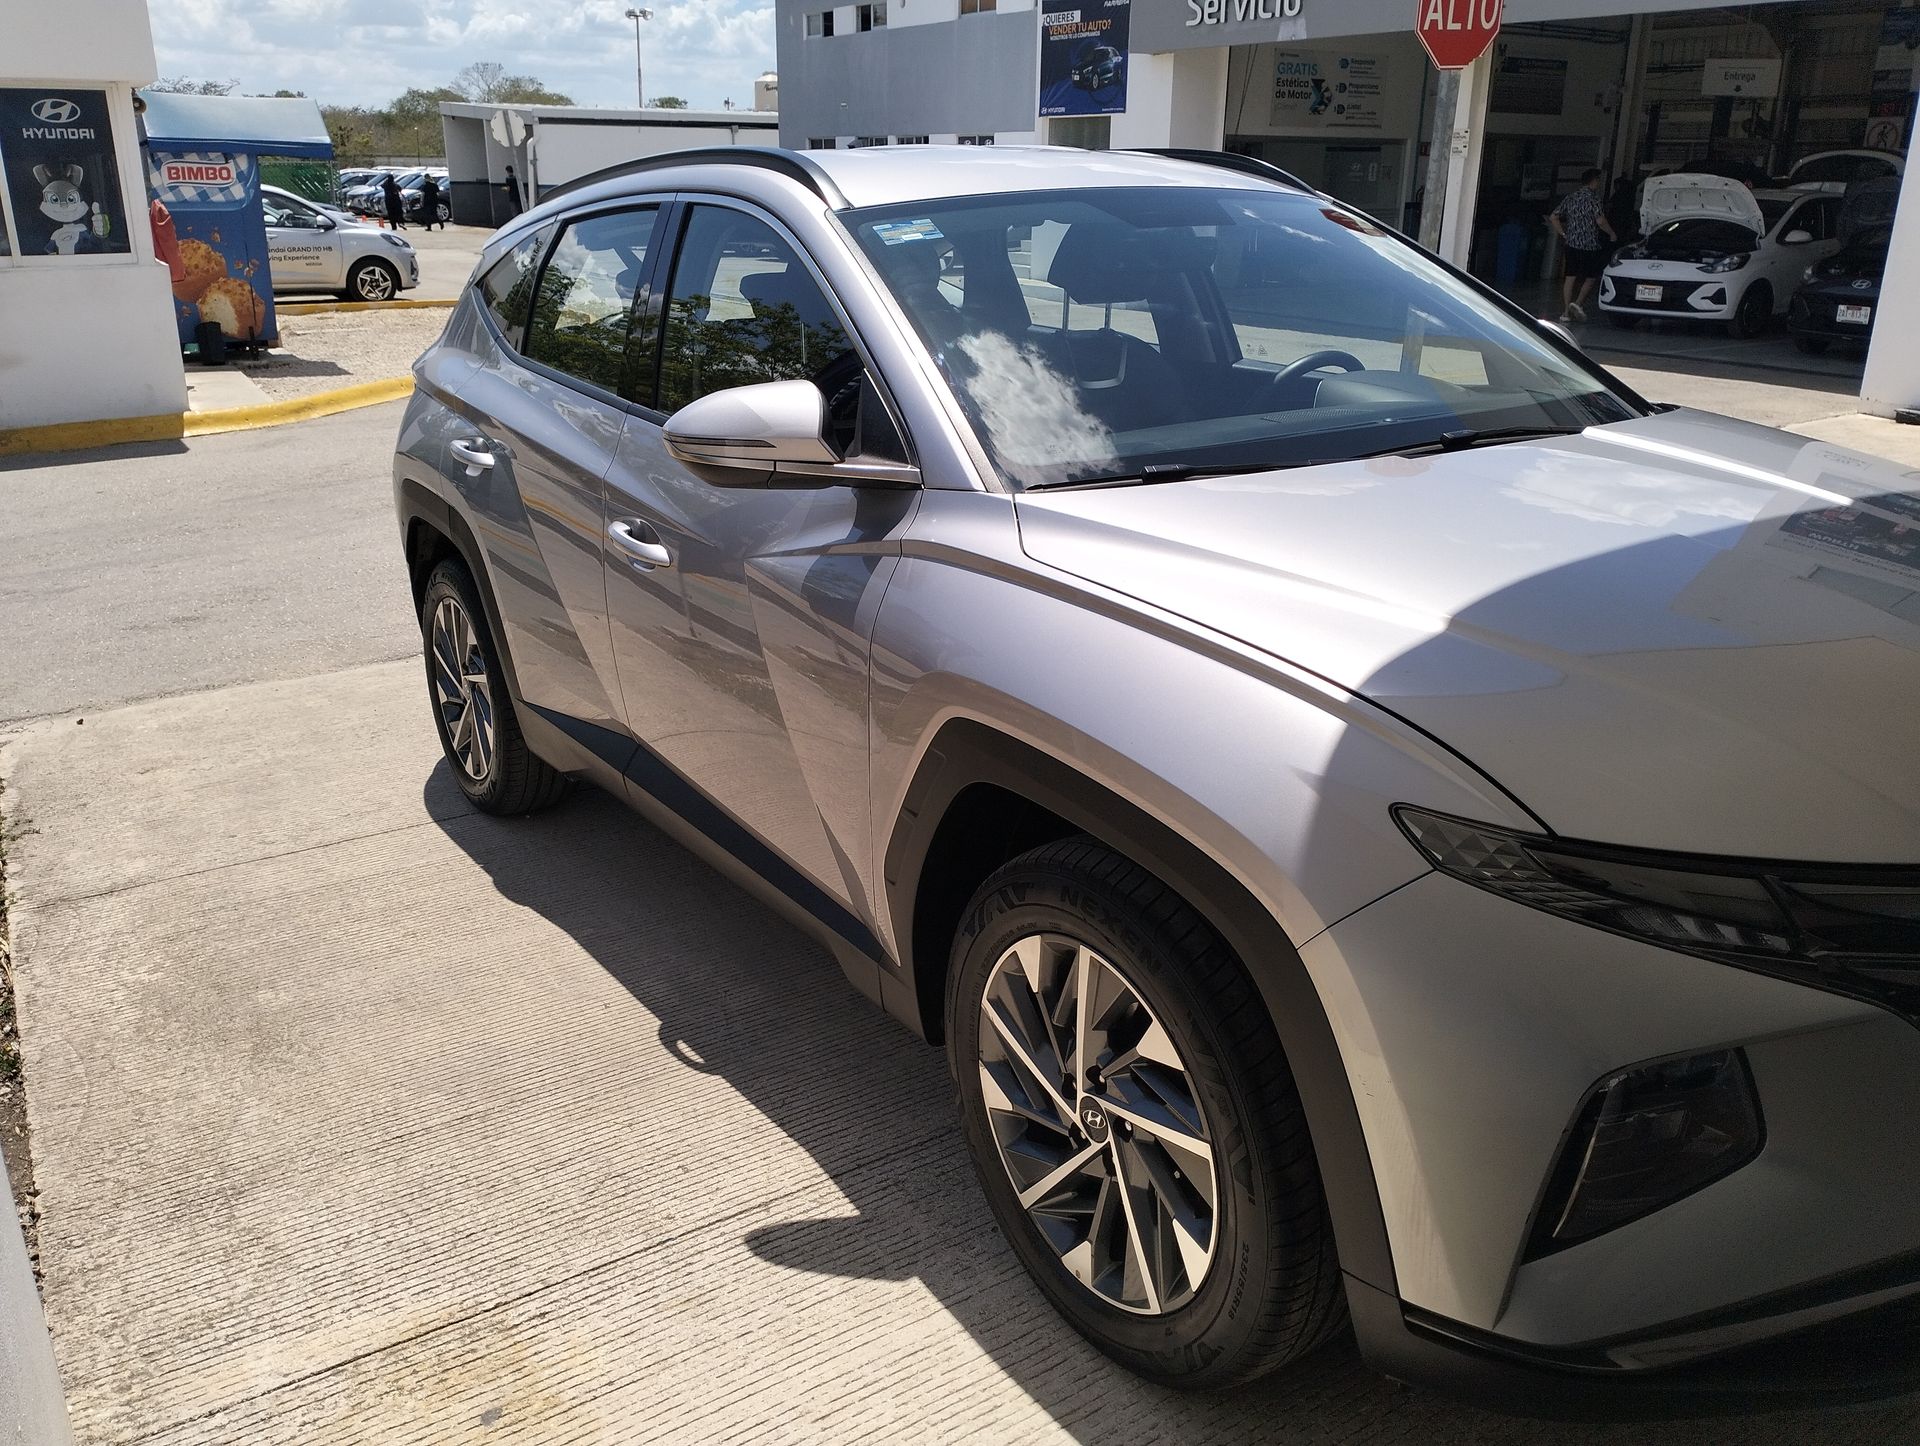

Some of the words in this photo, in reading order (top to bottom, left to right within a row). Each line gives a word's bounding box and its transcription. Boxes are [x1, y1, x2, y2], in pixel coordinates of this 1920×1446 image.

[1423, 0, 1499, 31] ALTO
[1049, 24, 1077, 35] VENDER
[1078, 22, 1087, 32] TU
[1088, 19, 1112, 31] AUTO?
[1277, 62, 1318, 76] GRATIS
[1276, 77, 1310, 88] Estética
[1724, 71, 1756, 83] Entrega
[1275, 89, 1287, 99] de
[1287, 90, 1312, 99] Motor
[22, 127, 95, 140] HYUNDAI
[167, 166, 232, 181] BIMBO
[283, 254, 320, 262] Experience
[1060, 885, 1163, 975] NEXEN
[1227, 1241, 1250, 1320] 235/55R18
